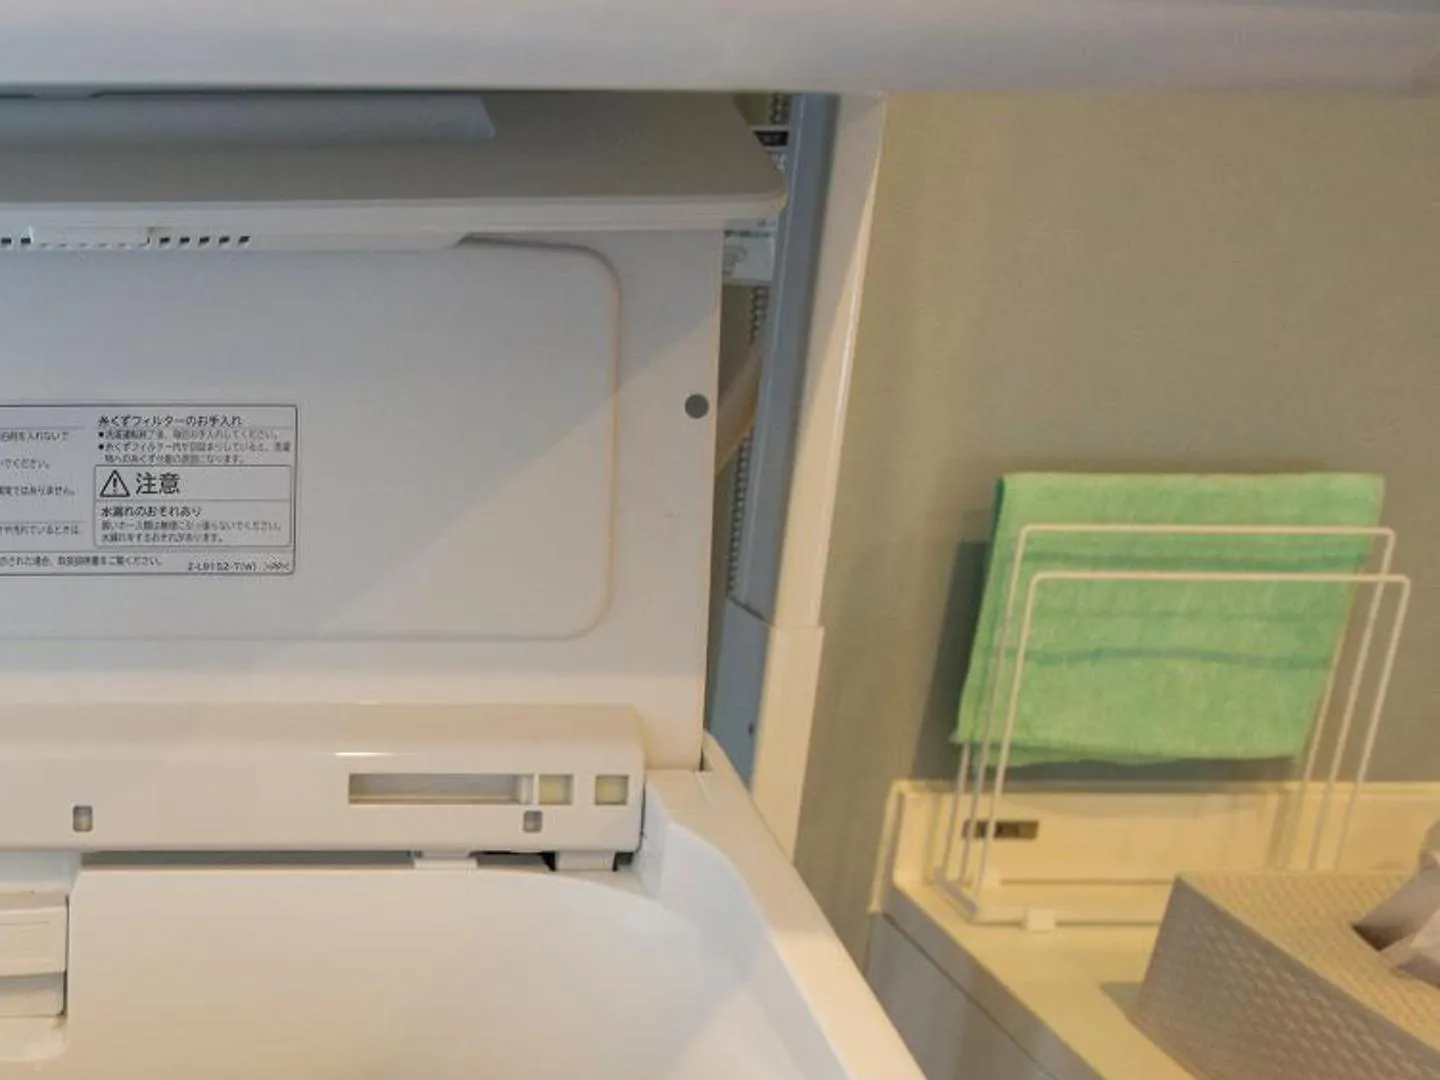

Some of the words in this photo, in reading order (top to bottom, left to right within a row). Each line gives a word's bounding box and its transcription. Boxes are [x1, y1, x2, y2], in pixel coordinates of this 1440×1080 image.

[97, 414, 243, 428] 糸くずフィルターのお手入れ
[135, 471, 182, 495] 注意
[101, 505, 203, 517] 水漏れのおそれあり
